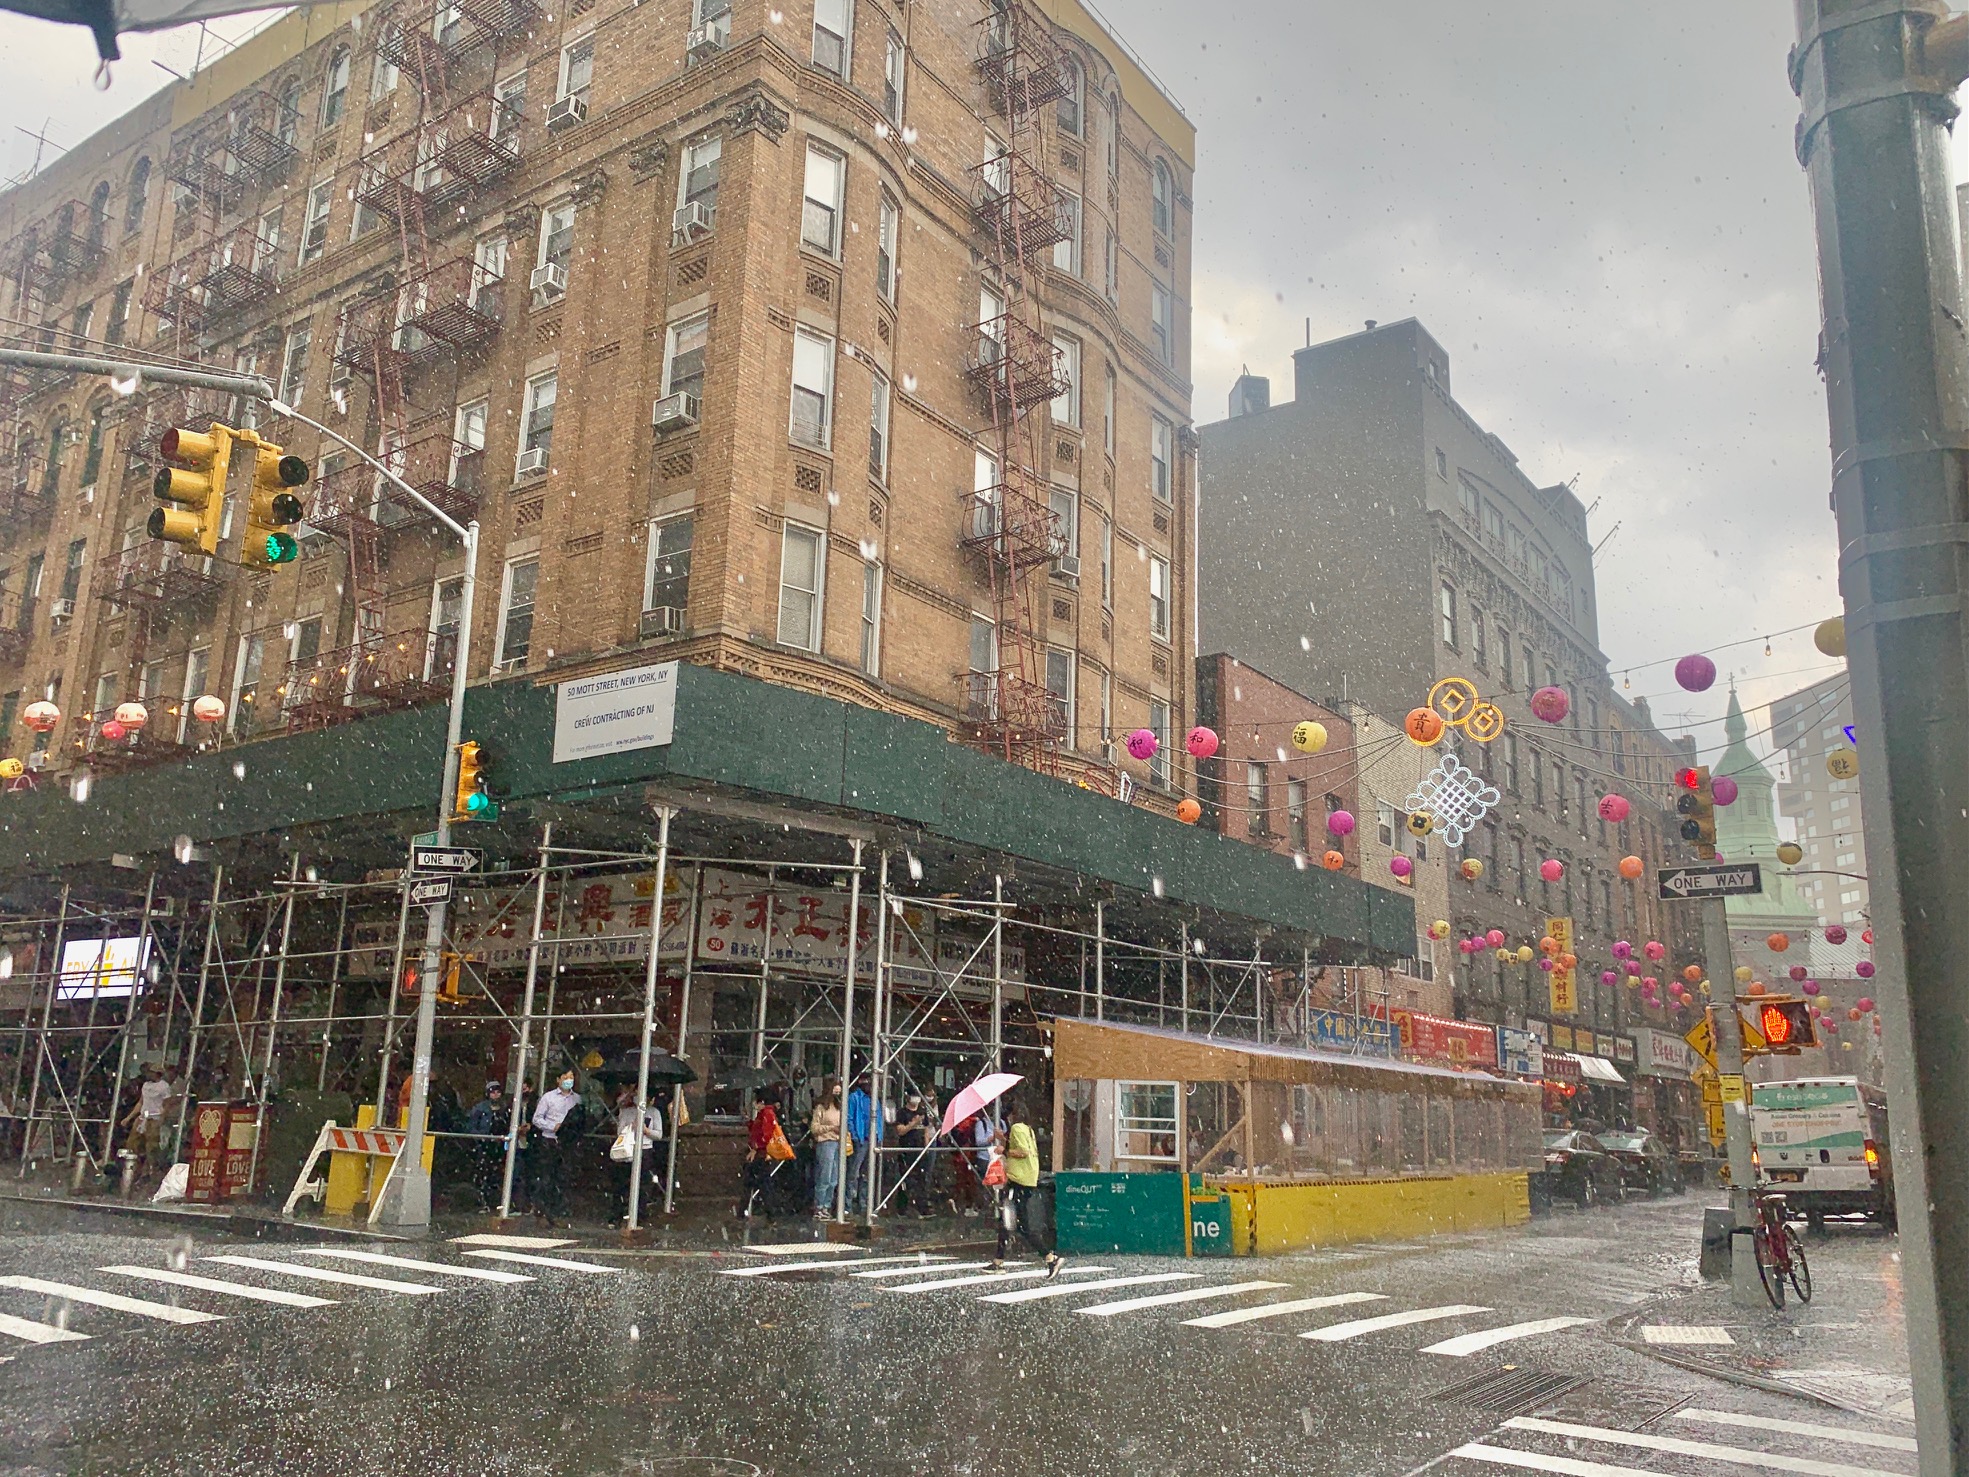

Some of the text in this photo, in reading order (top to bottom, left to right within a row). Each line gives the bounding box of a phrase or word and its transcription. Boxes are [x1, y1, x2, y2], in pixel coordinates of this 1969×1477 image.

[567, 669, 669, 697] 50 MOTT STREET, NEW YORK, NY
[574, 703, 655, 729] CREW CONTRACTING OF NJ
[1129, 738, 1144, 750] 和
[1189, 732, 1204, 744] 和
[423, 854, 472, 866] ONE WAY
[1673, 873, 1747, 890] ONE WAY
[414, 884, 446, 898] ONE WAY
[709, 940, 721, 949] 50
[192, 1159, 217, 1177] LOVE
[226, 1161, 251, 1175] LOVE
